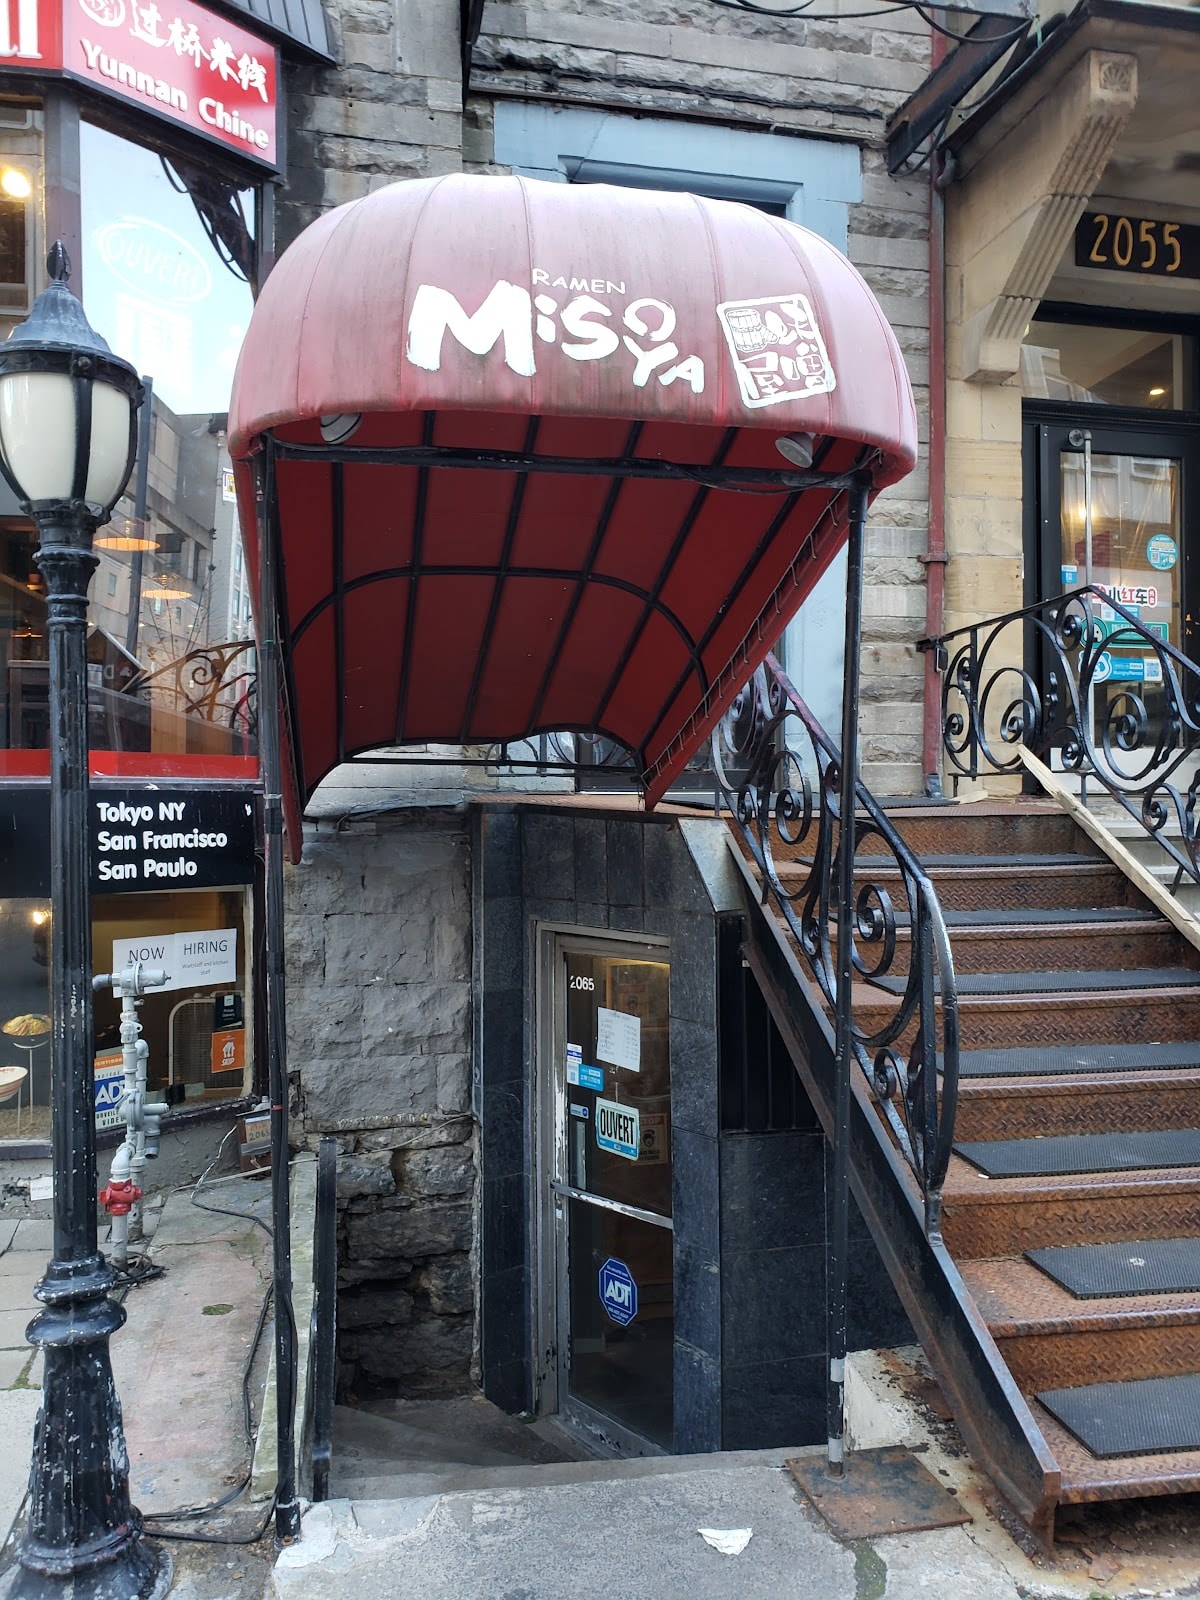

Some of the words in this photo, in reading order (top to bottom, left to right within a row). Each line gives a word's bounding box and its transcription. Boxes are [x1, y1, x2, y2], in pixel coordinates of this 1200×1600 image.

[80, 38, 188, 112] Yunnan
[198, 97, 269, 150] Chine
[1089, 215, 1181, 272] 2055
[532, 267, 626, 295] RAMEN
[96, 802, 153, 827] Tokyo
[159, 802, 185, 821] NY
[98, 831, 136, 851] San
[143, 828, 228, 850] Francisco
[98, 860, 137, 880] San
[143, 857, 198, 877] Paulo
[129, 946, 165, 962] NOW
[183, 940, 228, 955] HIRING
[569, 975, 595, 991] 2065
[600, 1108, 635, 1145] OUVERT
[605, 1279, 631, 1307] ADT
